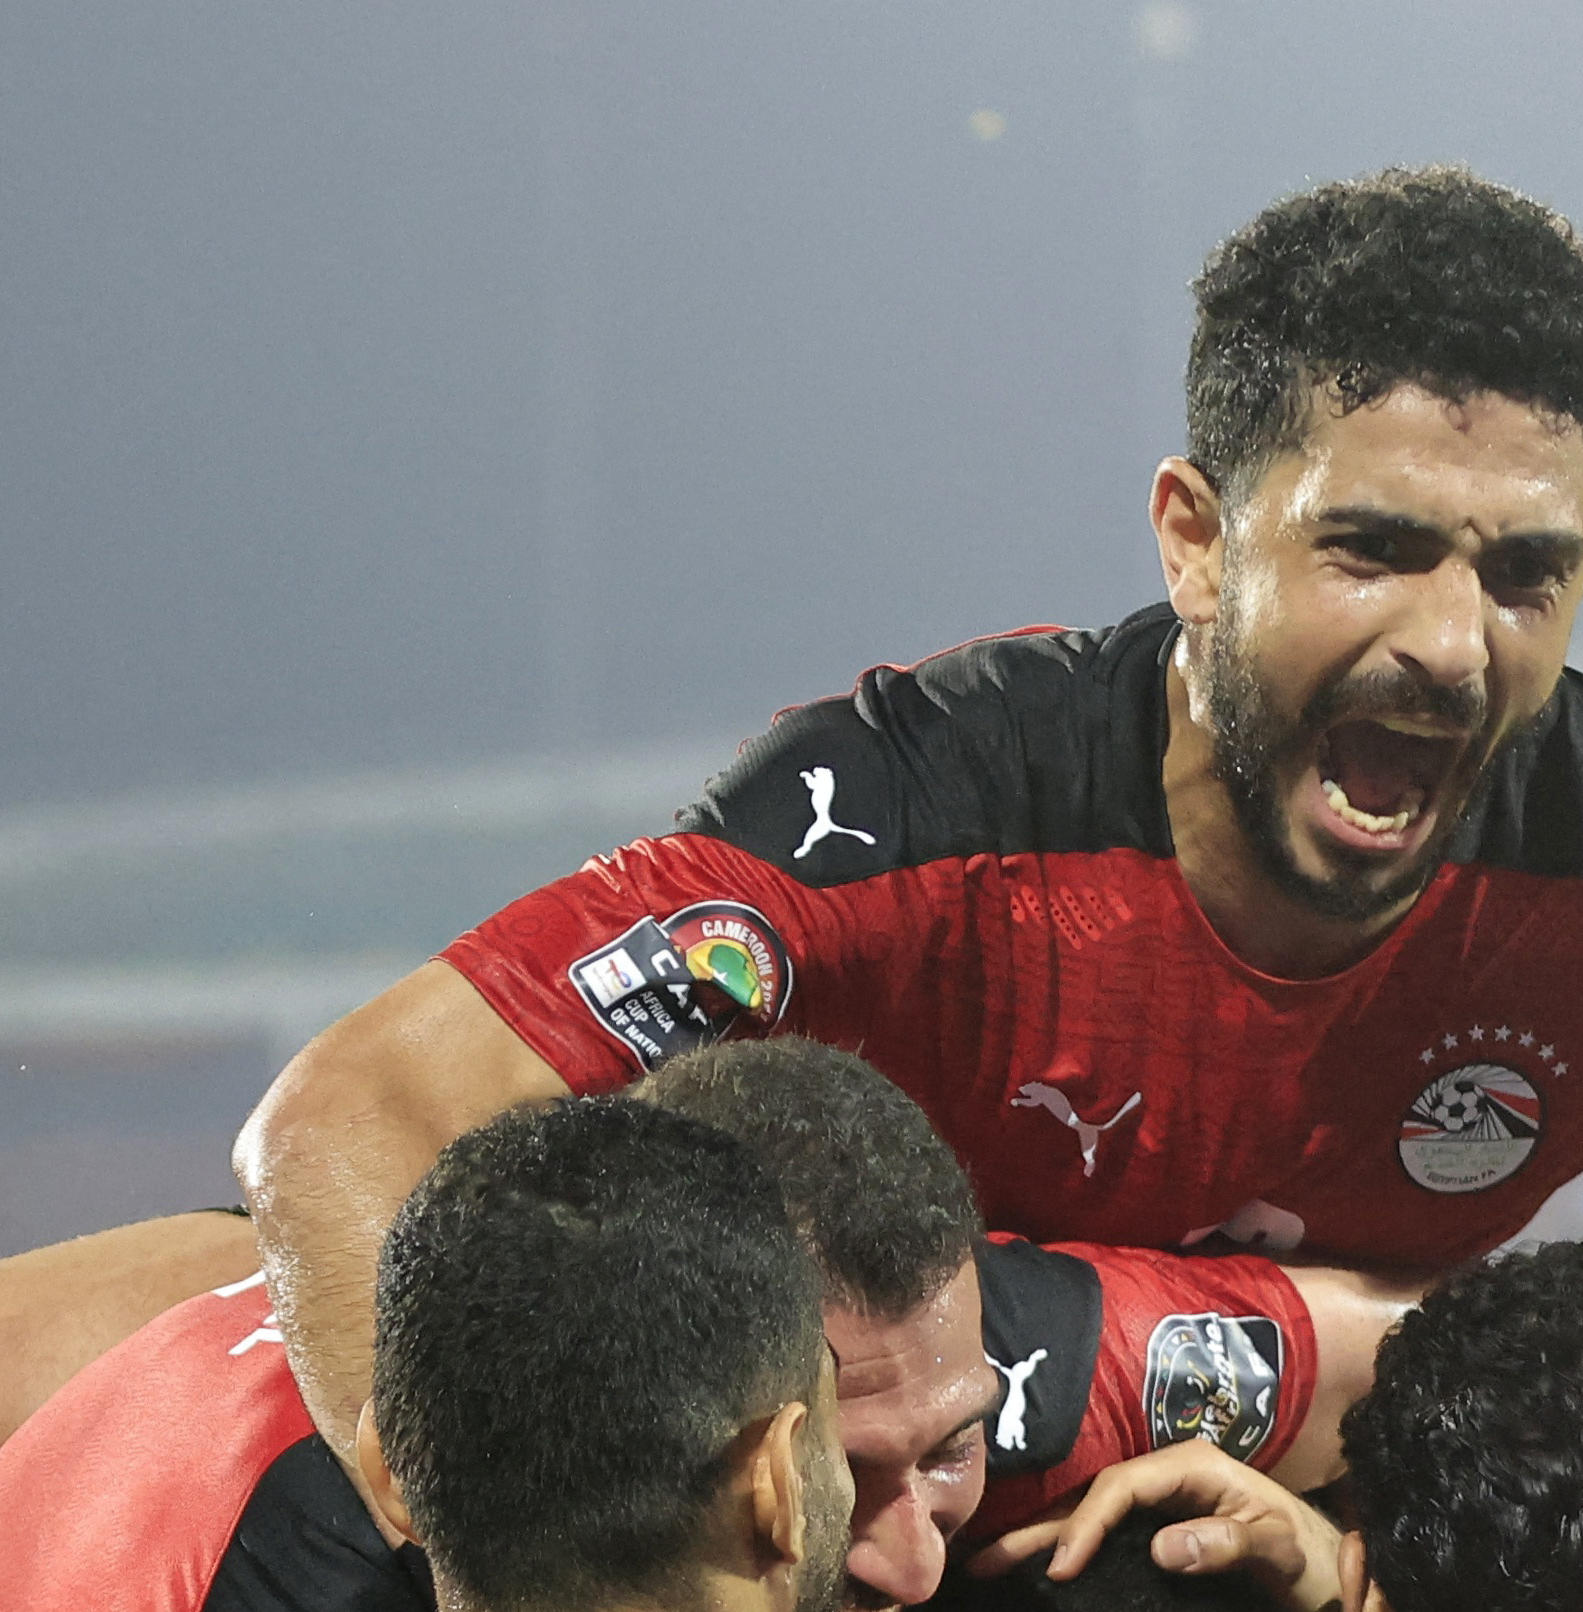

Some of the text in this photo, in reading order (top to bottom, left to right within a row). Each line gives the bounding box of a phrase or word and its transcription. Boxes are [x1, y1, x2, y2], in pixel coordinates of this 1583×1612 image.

[701, 919, 774, 977] CAMEROON
[610, 1007, 631, 1026] OF
[624, 998, 649, 1022] CUP
[639, 990, 676, 1035] AFRICA
